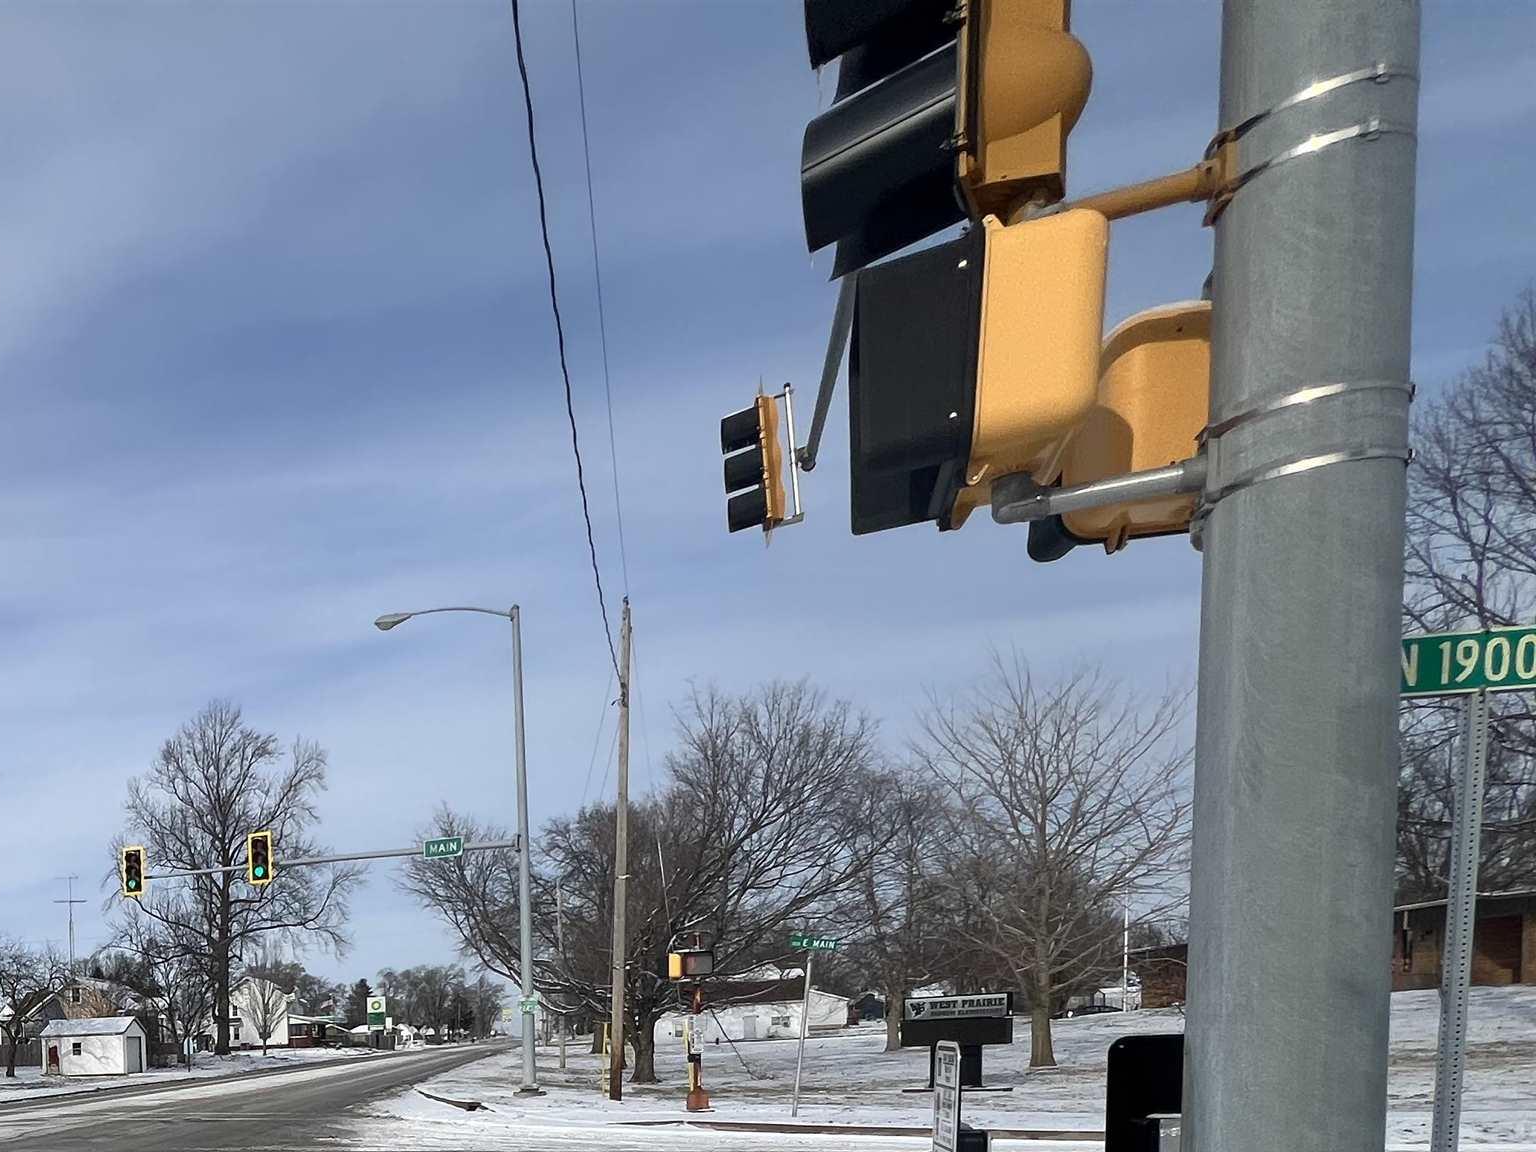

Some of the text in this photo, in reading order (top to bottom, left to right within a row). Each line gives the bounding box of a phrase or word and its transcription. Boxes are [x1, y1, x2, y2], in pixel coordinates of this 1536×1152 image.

[1438, 633, 1536, 686] 1900
[429, 841, 457, 854] MAIN
[802, 938, 809, 947] E
[812, 939, 835, 949] MAIN
[929, 997, 1005, 1010] WEST PRAIRIE
